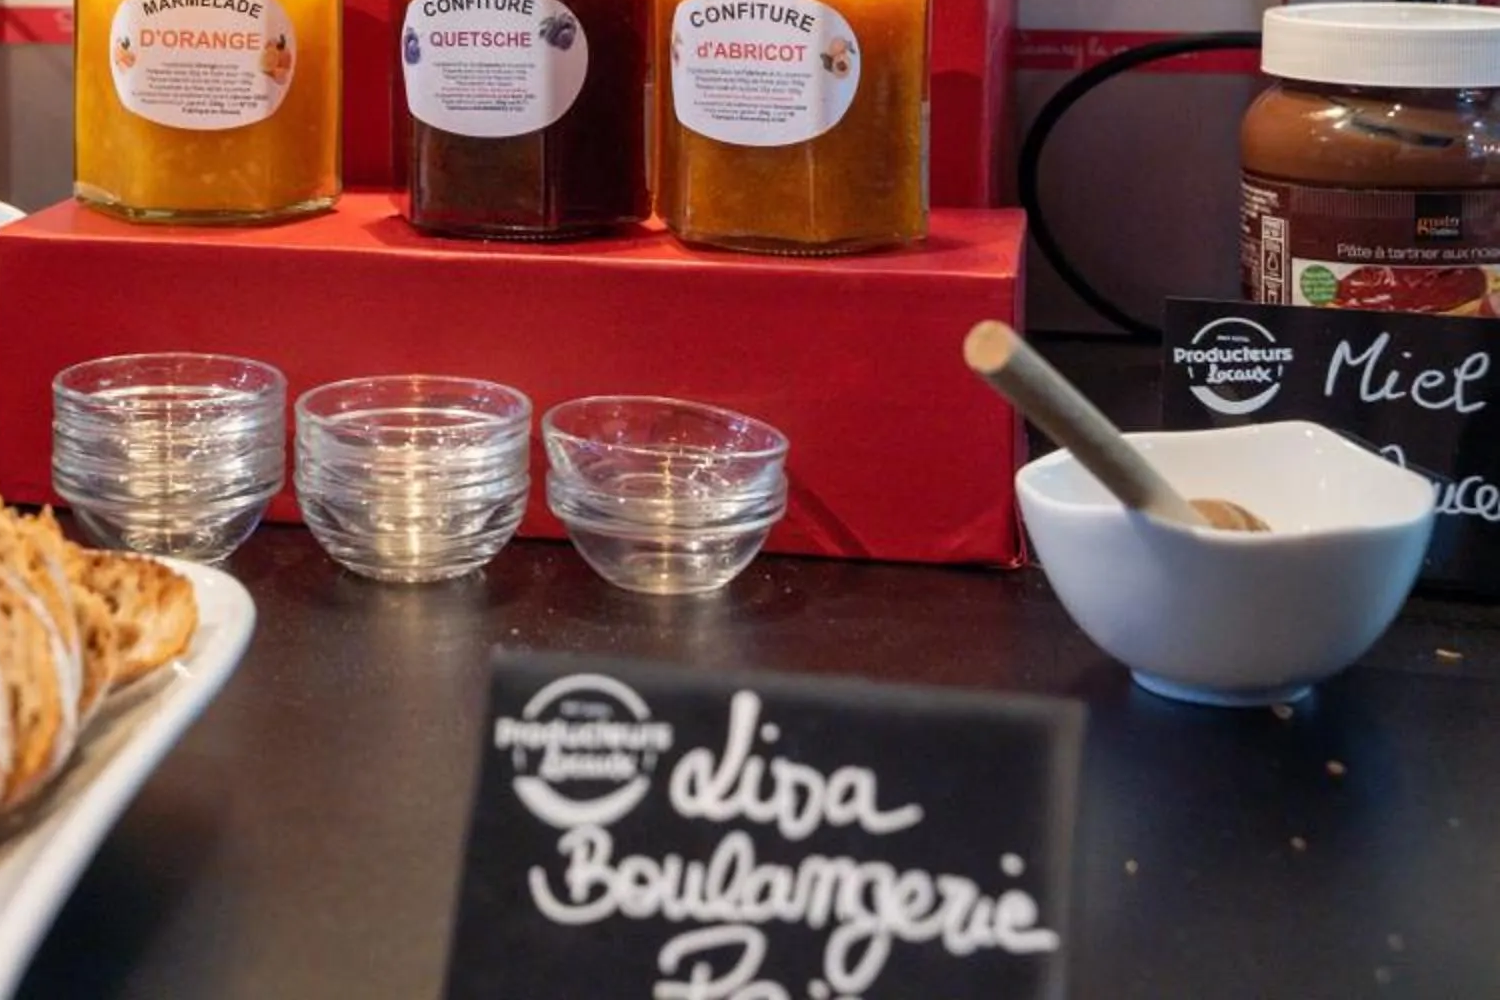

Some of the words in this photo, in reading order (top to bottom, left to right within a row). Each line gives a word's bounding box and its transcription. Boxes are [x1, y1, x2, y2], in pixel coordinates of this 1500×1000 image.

[689, 1, 816, 34] CONFITURE
[139, 29, 261, 51] D'ORANGE
[429, 31, 533, 48] QUETSCHE
[696, 42, 808, 63] d'ABRICOT
[1173, 346, 1294, 364] Producteurs
[1205, 362, 1273, 384] Locaux
[1324, 331, 1491, 414] Miel
[528, 821, 1061, 994] Boulangerie
